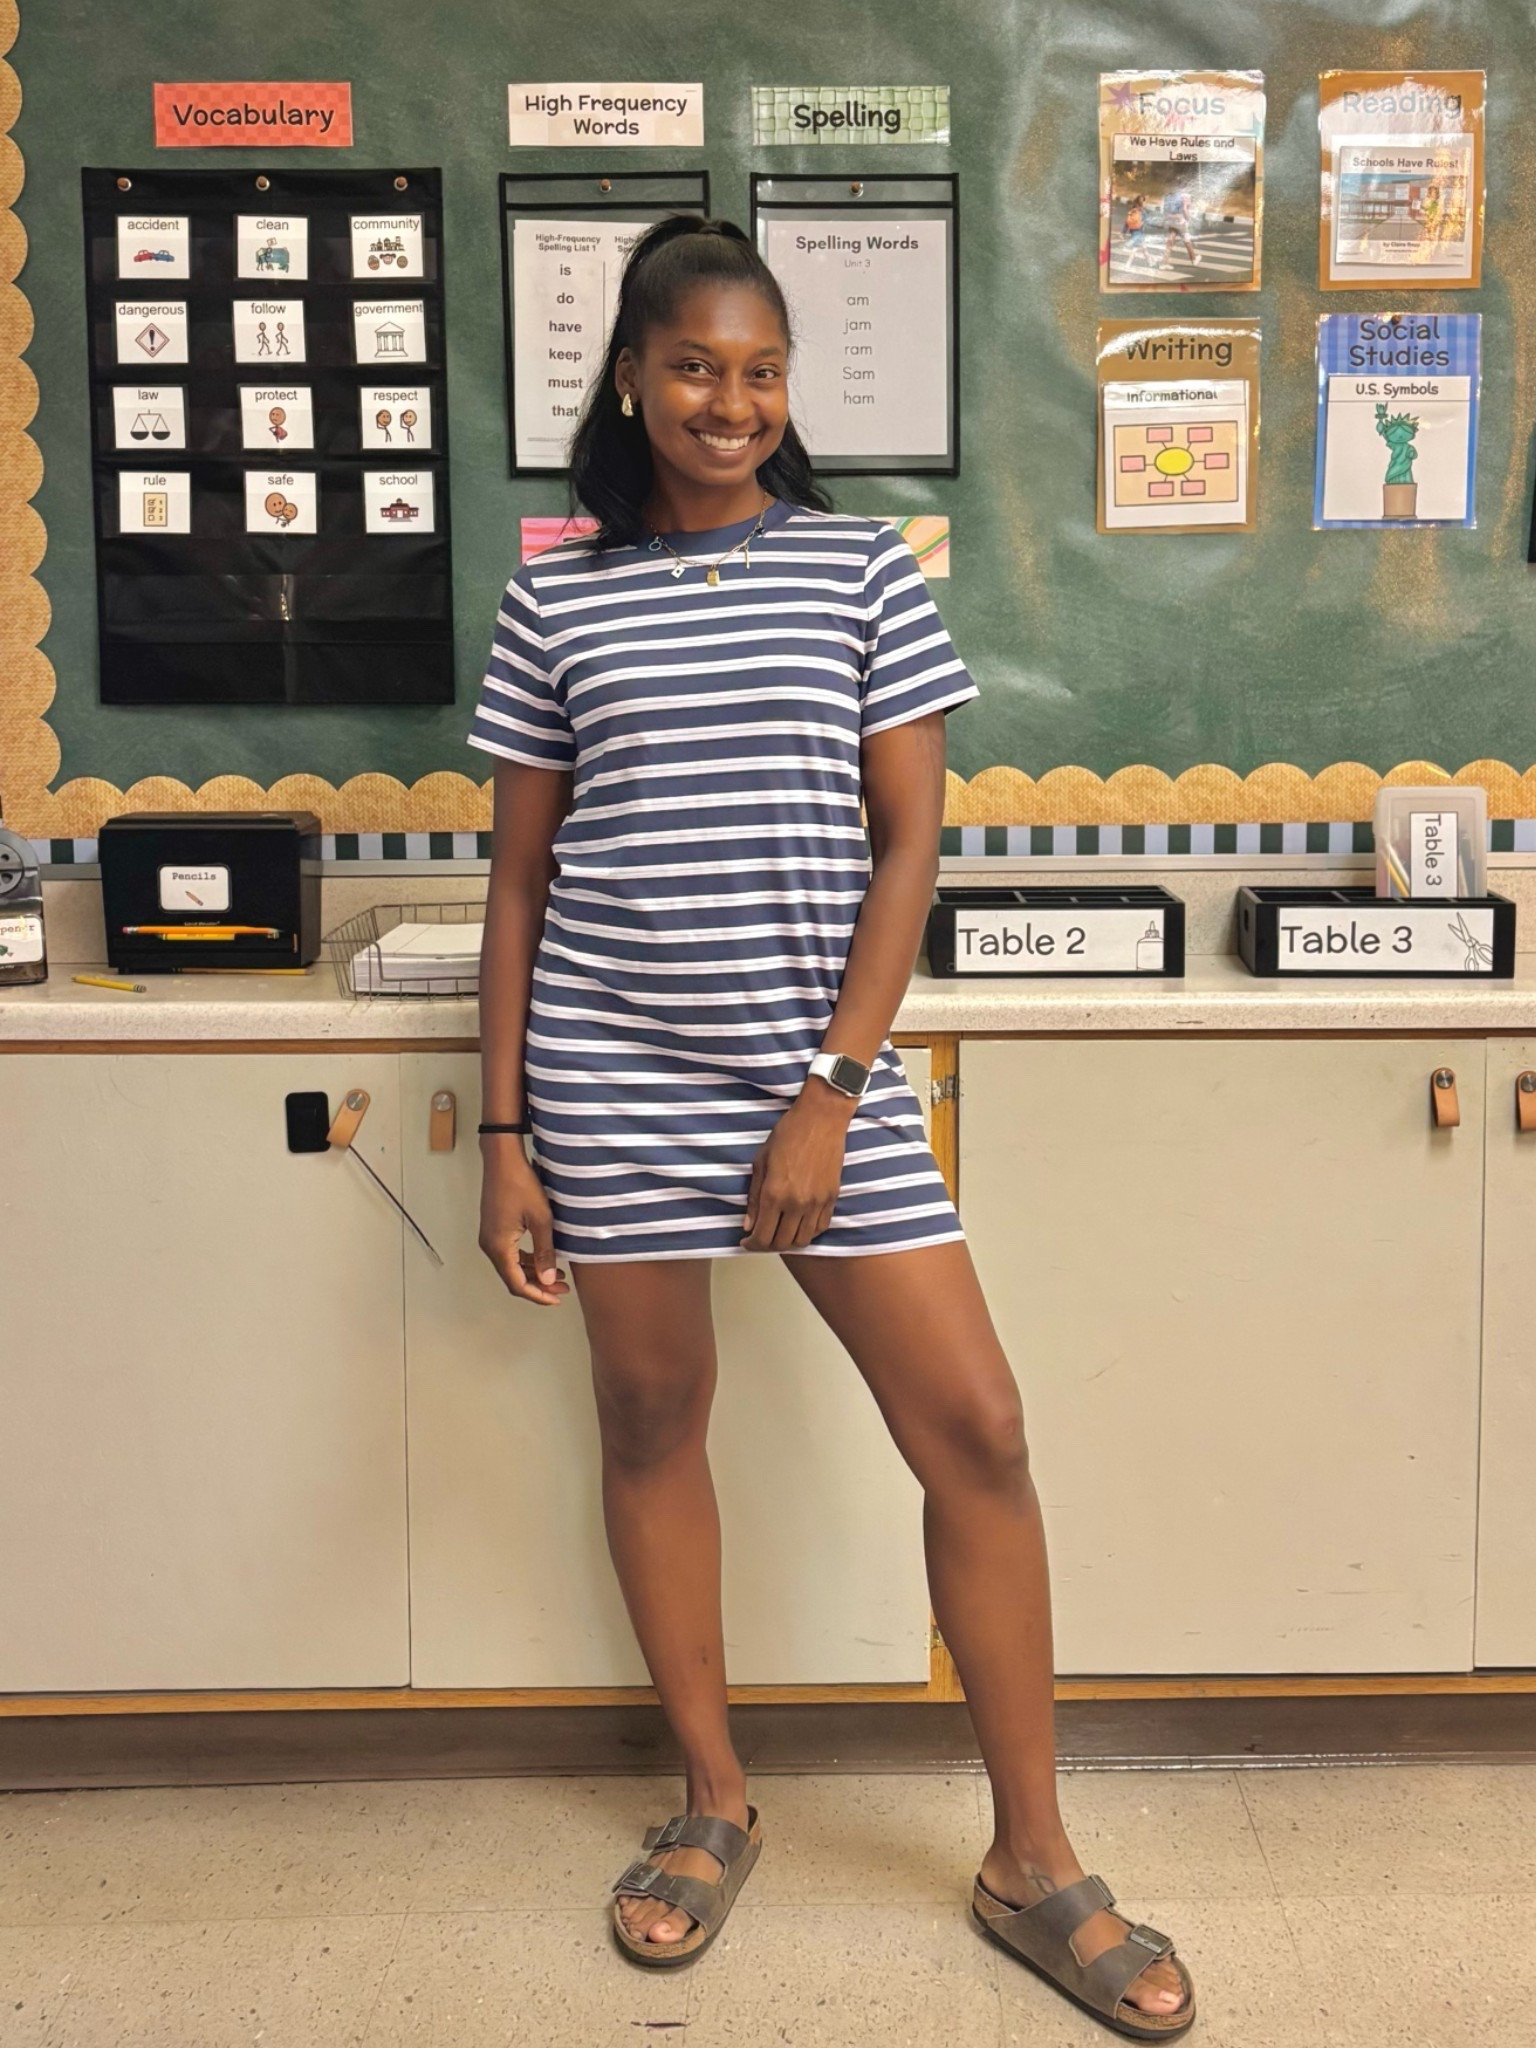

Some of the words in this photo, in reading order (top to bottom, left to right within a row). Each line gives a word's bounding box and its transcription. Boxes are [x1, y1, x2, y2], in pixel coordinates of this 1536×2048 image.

[525, 94, 572, 116] High
[578, 95, 688, 116] Frequency
[1138, 91, 1226, 116] Focus
[1342, 90, 1462, 119] Reading
[172, 100, 335, 133] Vocabulary
[793, 100, 901, 135] Spelling
[573, 118, 640, 135] Words
[1130, 136, 1147, 147] We
[1149, 136, 1178, 148] Have
[1180, 137, 1211, 148] Rules
[1213, 137, 1235, 148] and
[1169, 151, 1198, 161] Laws
[1352, 157, 1394, 168] Schools
[1397, 157, 1423, 168] Have
[127, 218, 180, 231] accident
[256, 218, 289, 231] clean
[353, 218, 420, 233] community
[535, 233, 601, 244] High-Frequency
[796, 235, 861, 254] Spelling
[866, 235, 919, 250] Words
[538, 242, 572, 253] Spelling
[574, 243, 590, 252] List
[591, 244, 597, 252] 1
[559, 264, 572, 276] is
[844, 259, 862, 268] Unit
[864, 259, 871, 268] 3
[556, 292, 575, 305] do
[846, 295, 870, 307] am
[118, 304, 185, 317] dangerous
[251, 302, 286, 315] follow
[354, 303, 424, 318] government
[548, 320, 583, 333] have
[842, 318, 872, 335] jam
[1360, 316, 1440, 341] Social
[548, 348, 583, 364] keep
[844, 344, 873, 356] ram
[1126, 337, 1233, 367] Writing
[1349, 344, 1450, 367] Studies
[842, 366, 876, 380] Sam
[548, 377, 584, 390] must
[1355, 382, 1380, 396] U.S.
[1383, 381, 1439, 398] Symbols
[137, 389, 159, 401] law
[254, 389, 298, 404] protect
[373, 390, 418, 404] respect
[843, 390, 875, 405] ham
[1127, 389, 1218, 403] Informational
[551, 404, 579, 417] that
[143, 474, 167, 487] rule
[267, 474, 294, 487] safe
[379, 474, 418, 487] school
[1425, 814, 1445, 869] Table
[172, 872, 217, 881] Pencils
[1425, 874, 1442, 887] 3
[958, 922, 1055, 956] Table
[1066, 926, 1086, 955] 2
[1281, 921, 1380, 954] Table
[1391, 925, 1413, 954] 3
